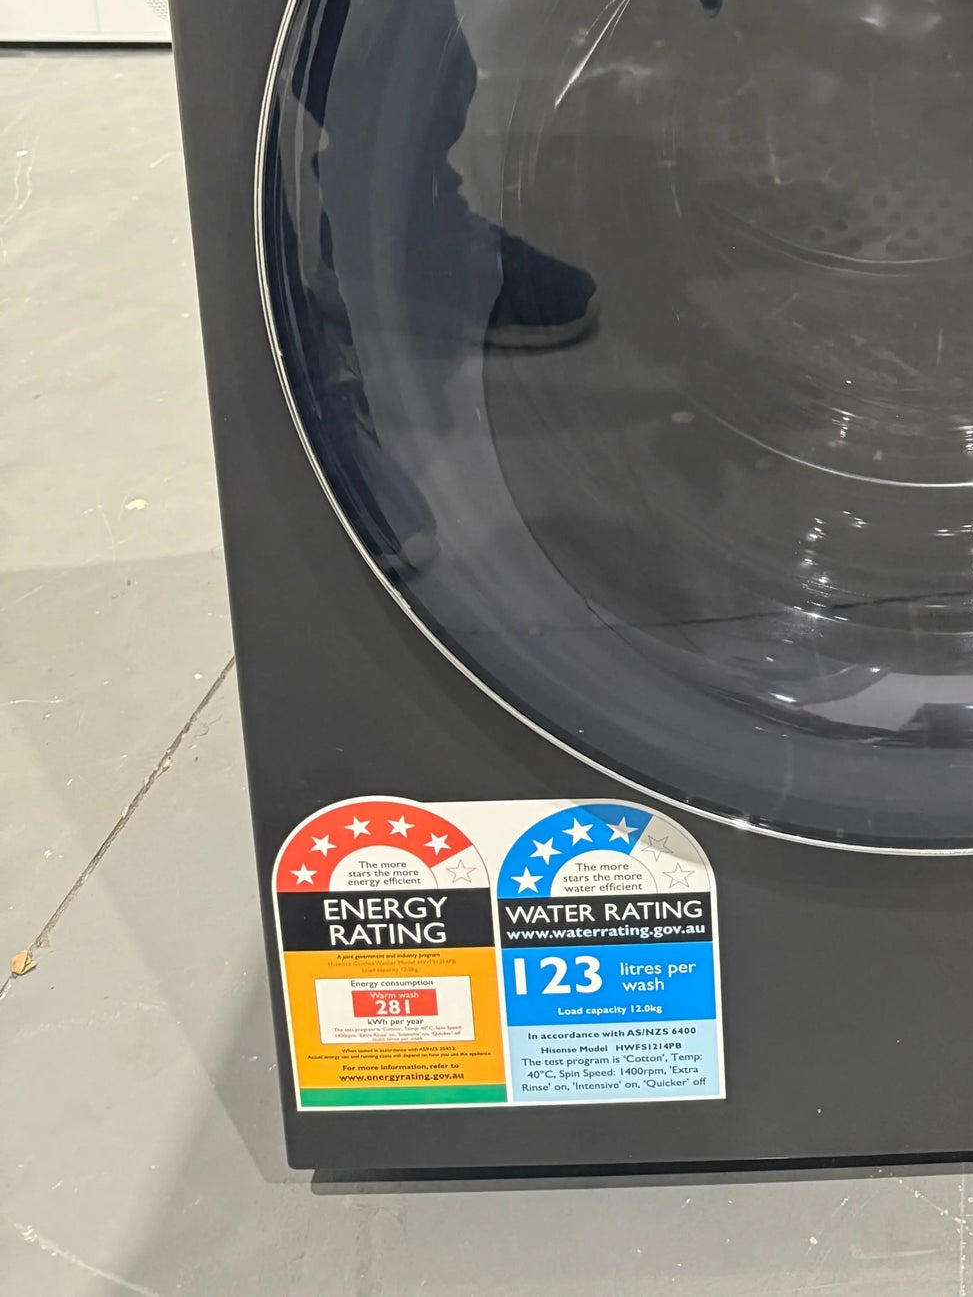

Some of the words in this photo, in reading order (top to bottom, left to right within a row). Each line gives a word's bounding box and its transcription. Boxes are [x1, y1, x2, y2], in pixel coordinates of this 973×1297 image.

[358, 861, 378, 869] The
[575, 863, 596, 871] The
[600, 863, 629, 871] more
[384, 877, 421, 885] efficient
[563, 874, 589, 882] stars
[593, 873, 610, 882] the
[564, 885, 596, 893] water
[600, 883, 642, 892] efficient
[324, 897, 447, 920] ENERGY
[505, 904, 595, 924] WATER
[605, 900, 702, 921] RATING
[330, 922, 446, 946] RATING
[506, 924, 705, 940] www.waterrating.gov.au
[514, 955, 603, 995] 123
[620, 962, 661, 975] litres
[668, 963, 696, 977] per
[351, 980, 378, 988] Energy
[381, 979, 433, 987] consumption
[622, 978, 664, 992] wash
[375, 999, 410, 1015] 281
[558, 1007, 583, 1015] Load
[586, 1006, 626, 1016] capacity
[630, 1005, 662, 1014] 12.0kg
[627, 1028, 669, 1036] AS/NZS
[672, 1027, 696, 1035] 6400
[521, 1058, 541, 1066] The
[567, 1057, 609, 1067] program
[671, 1053, 702, 1062] Temp:
[339, 1072, 464, 1081] www.energyrating.gov.au
[528, 1070, 556, 1079] 40°C,
[559, 1070, 580, 1080] Spin
[583, 1068, 615, 1079] Speed:
[621, 1067, 666, 1077] 1400rpm,
[522, 1083, 551, 1092] Rinse'
[693, 1077, 706, 1085] off
